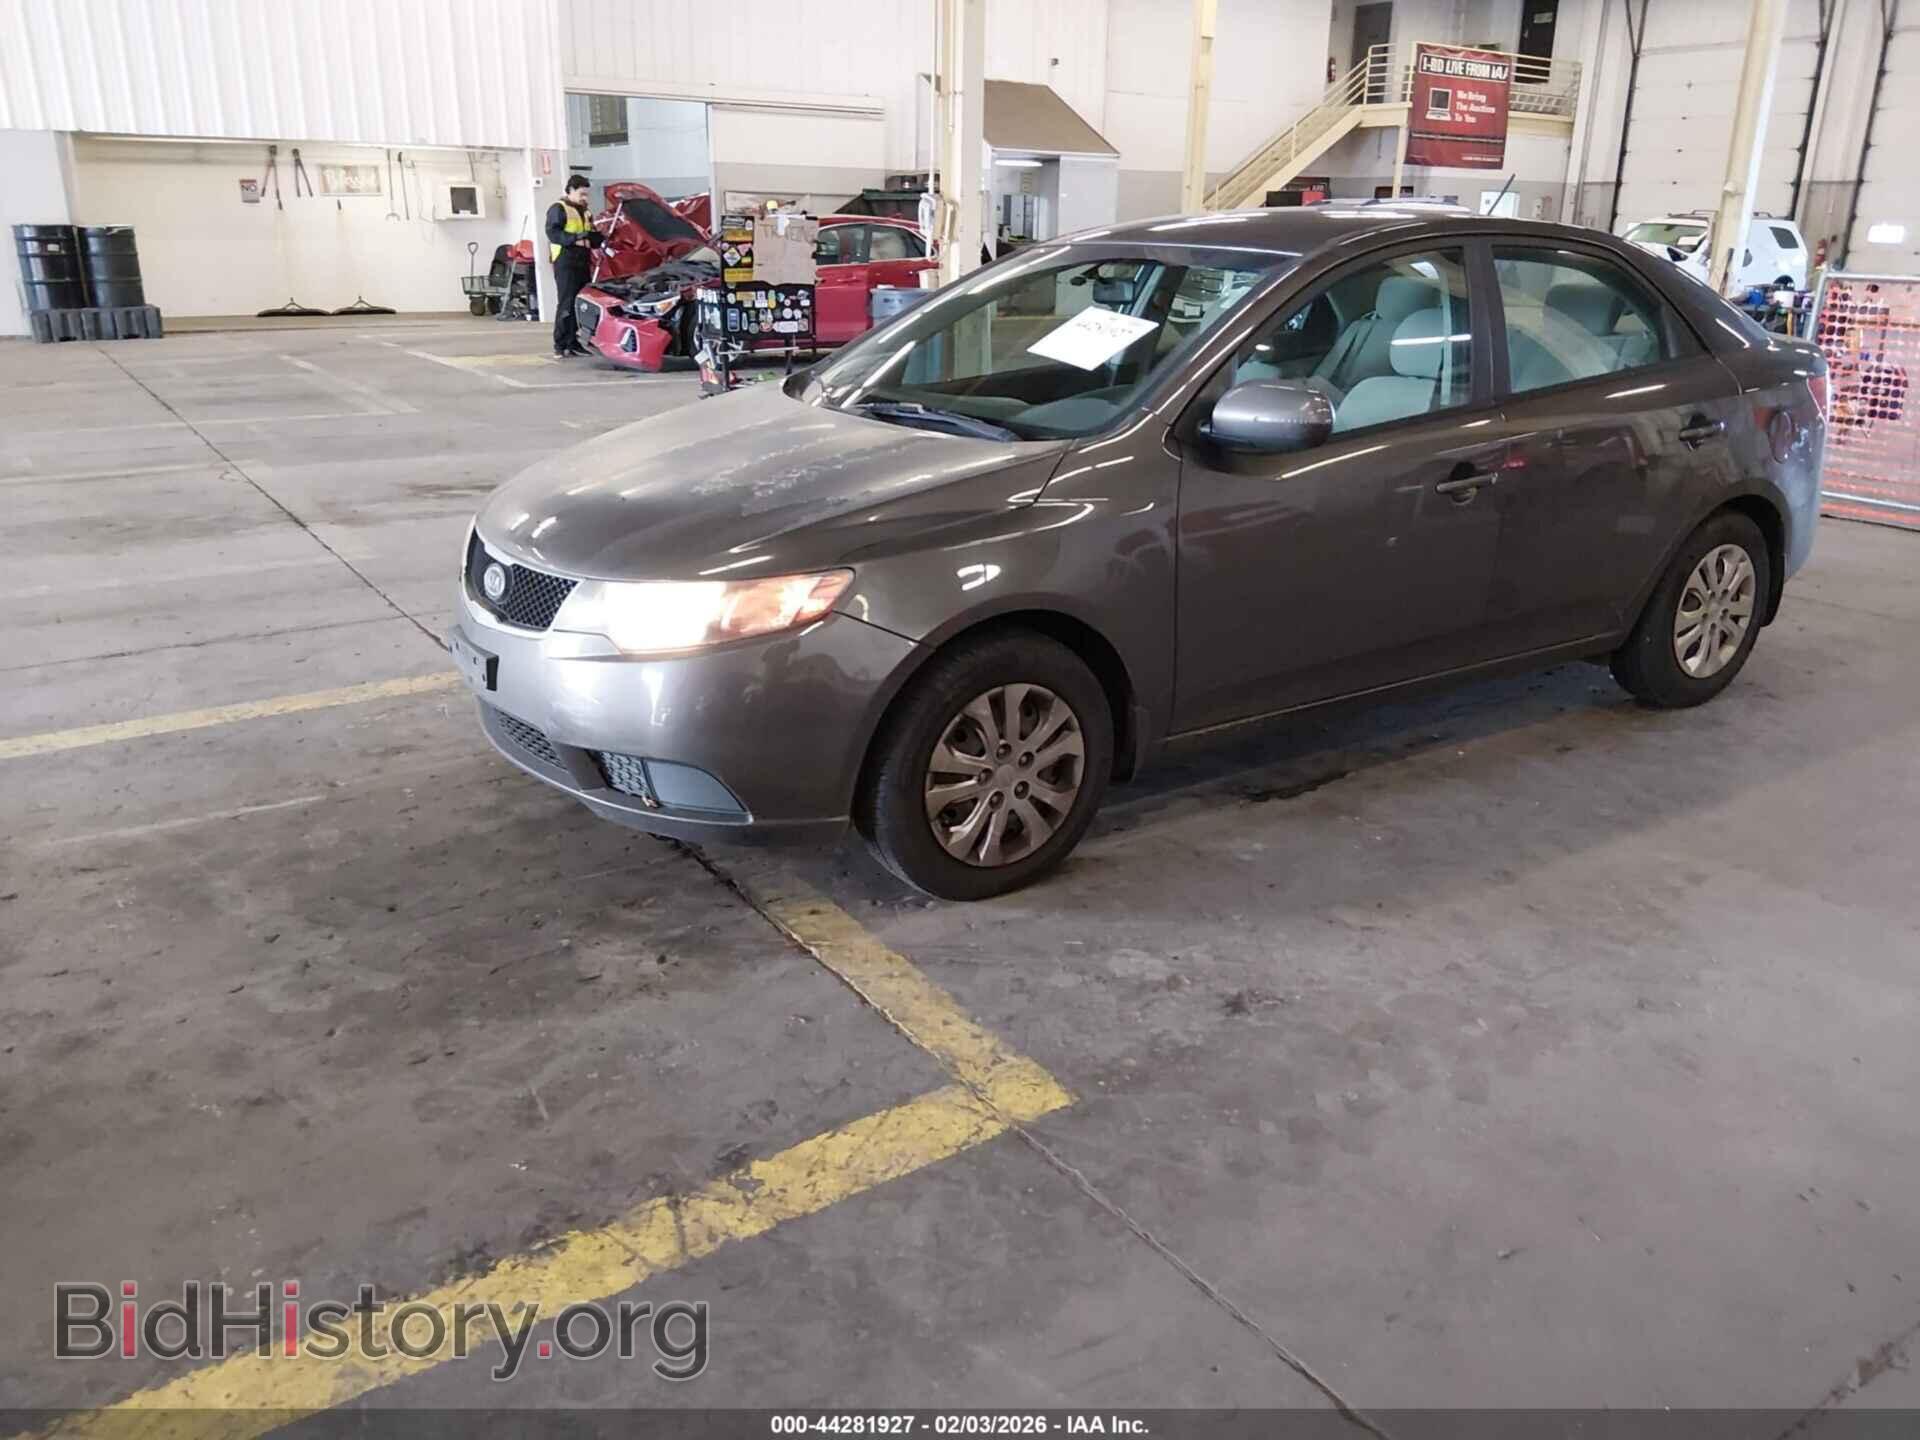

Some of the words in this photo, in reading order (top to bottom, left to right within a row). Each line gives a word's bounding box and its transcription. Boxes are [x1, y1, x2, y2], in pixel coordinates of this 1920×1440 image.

[1445, 60, 1464, 75] LIVE
[1465, 62, 1490, 78] FROM
[1456, 101, 1468, 111] The
[241, 183, 258, 193] NO
